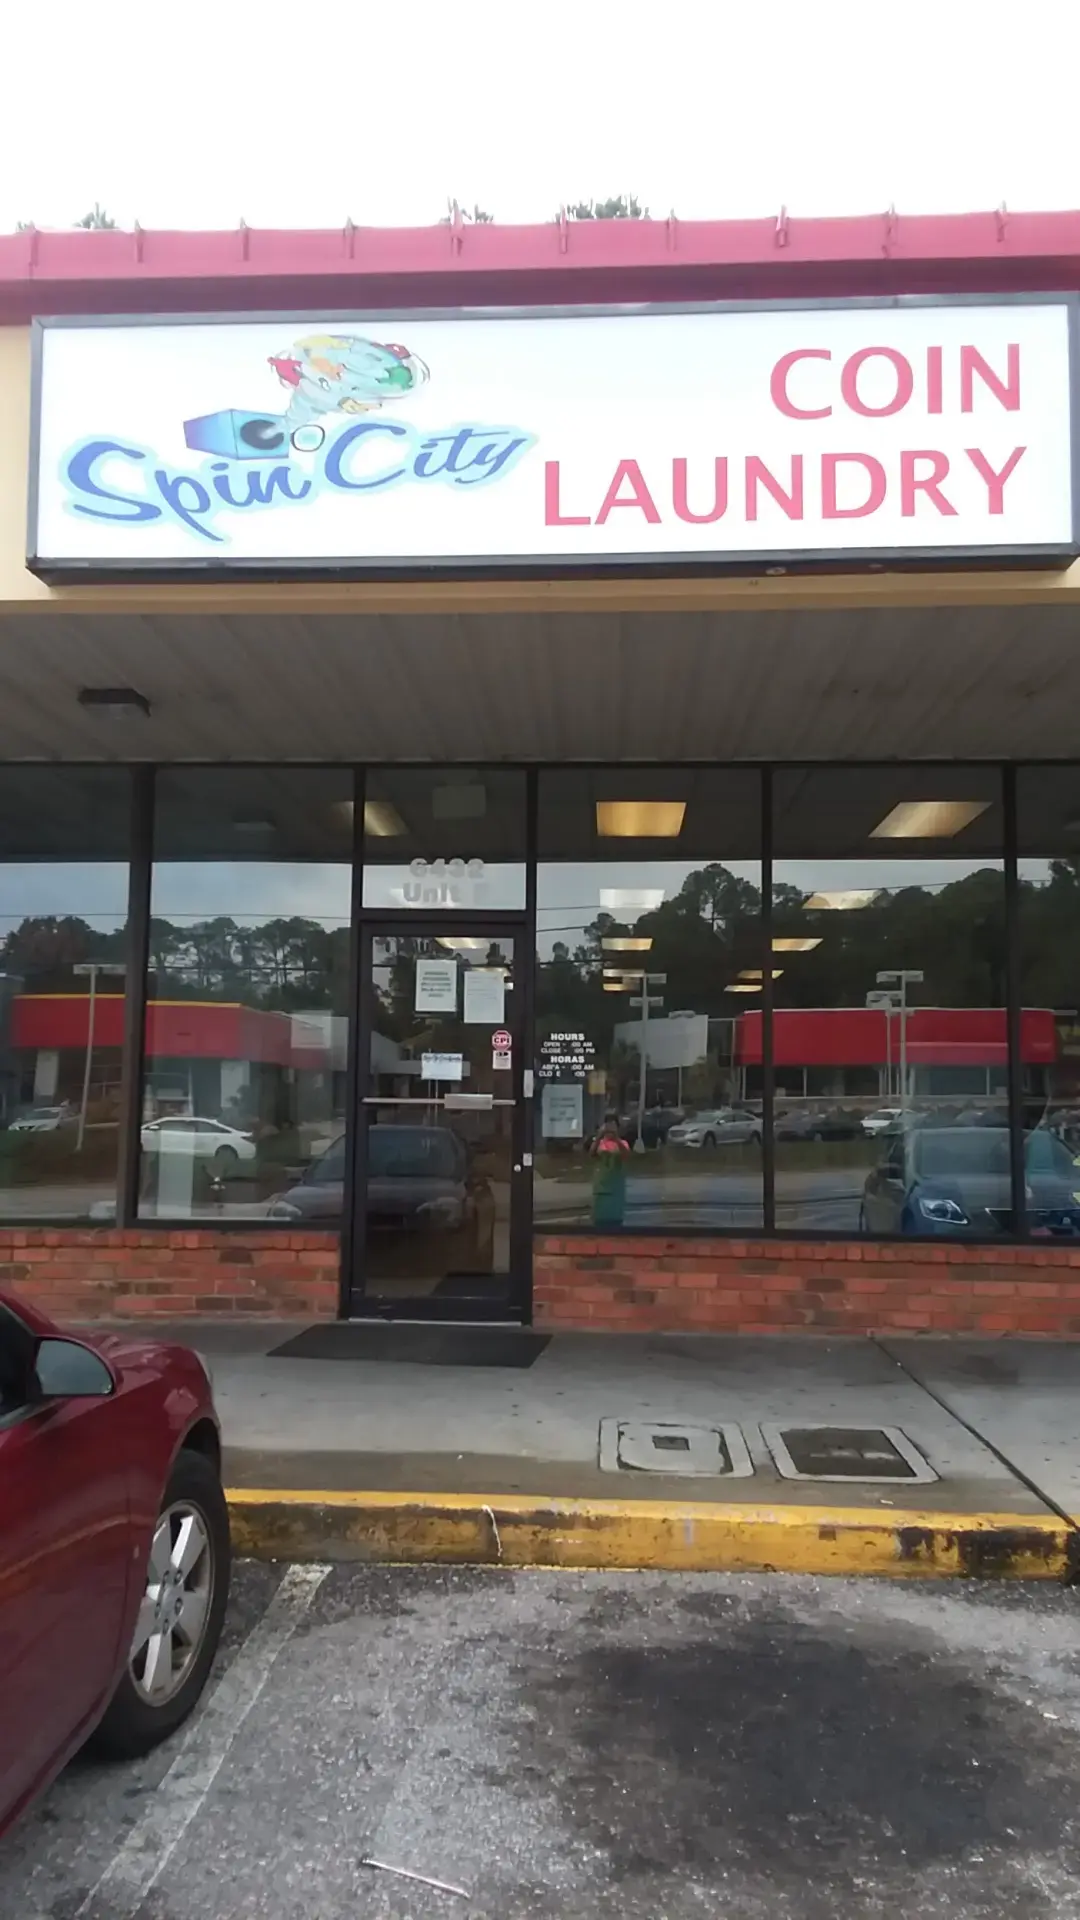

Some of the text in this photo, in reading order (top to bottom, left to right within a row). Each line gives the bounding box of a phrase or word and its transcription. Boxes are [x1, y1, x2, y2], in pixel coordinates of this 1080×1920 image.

[770, 343, 1021, 420] COIN
[67, 422, 528, 542] Spin City
[544, 446, 1027, 527] LAUNDRY
[410, 857, 485, 878] 6432
[403, 882, 461, 903] Unit
[550, 1032, 585, 1041] HOURS
[550, 1055, 585, 1064] HORAS
